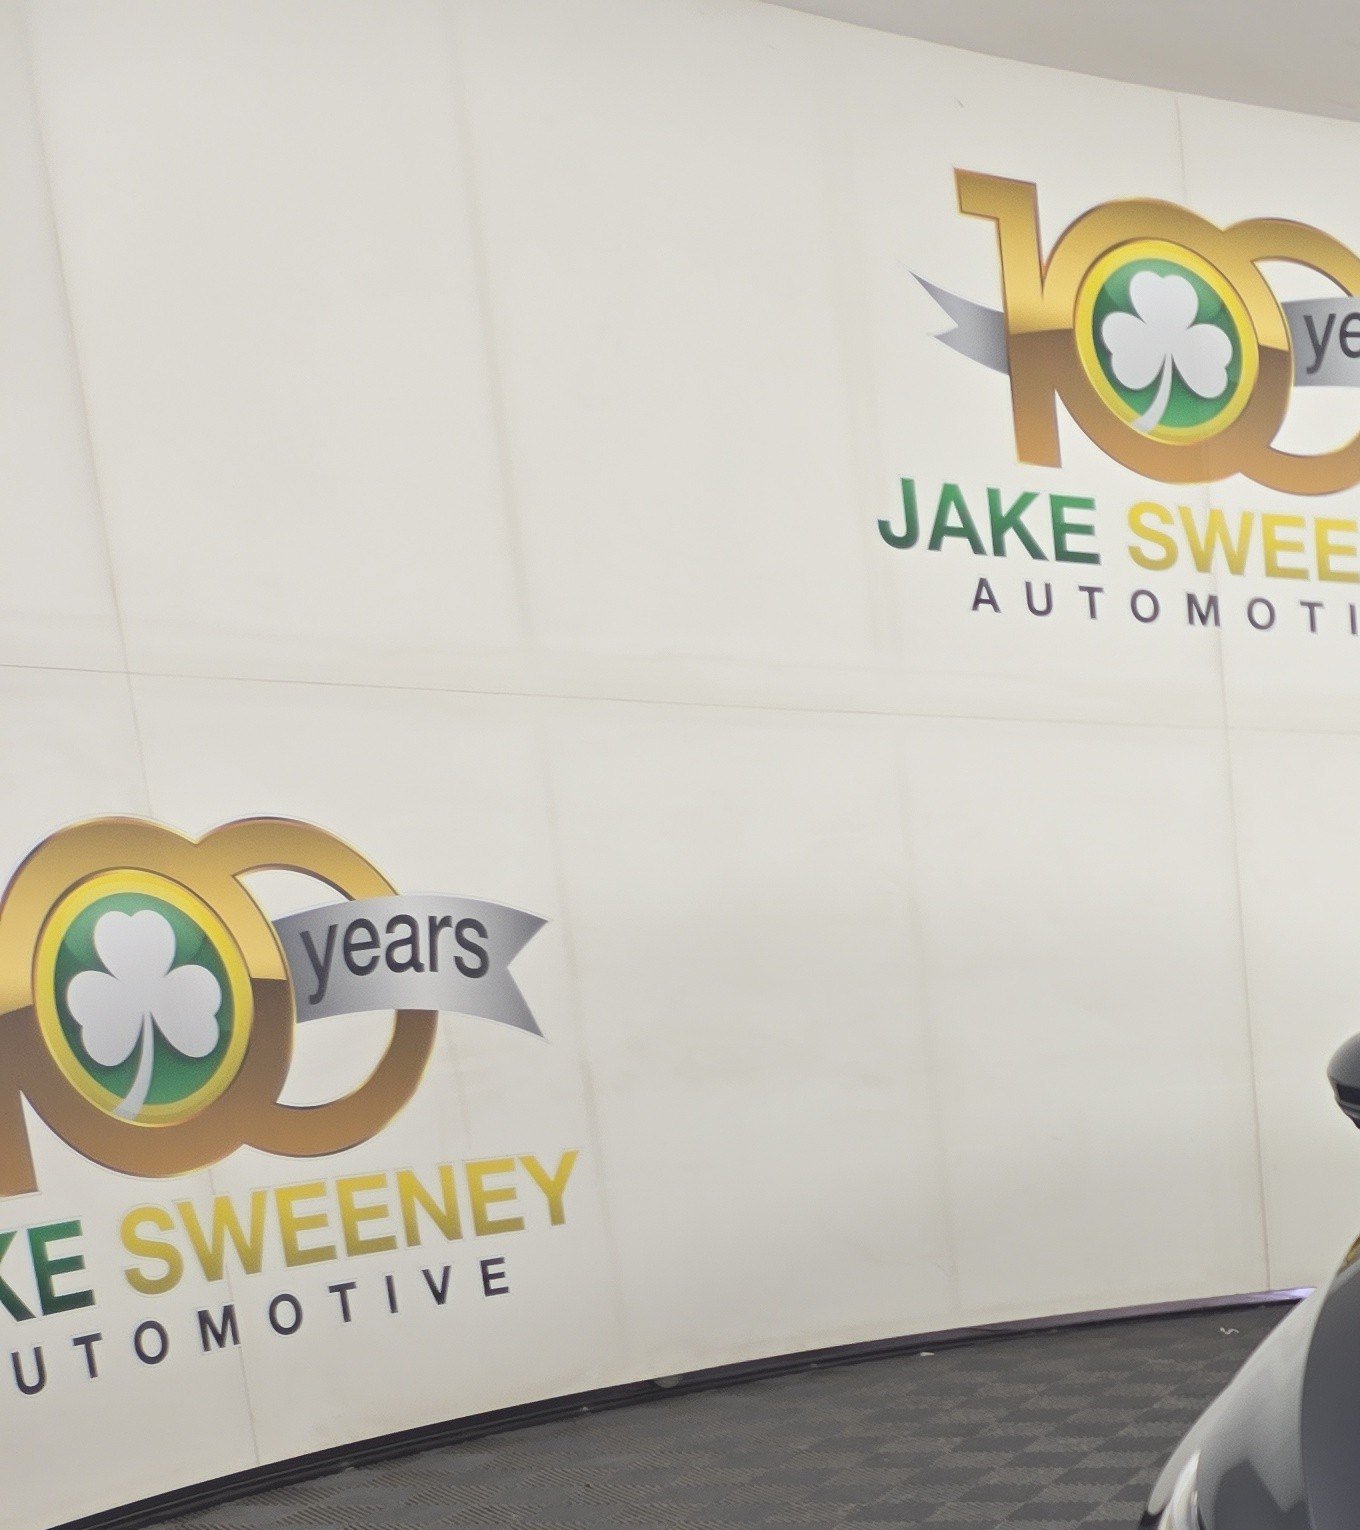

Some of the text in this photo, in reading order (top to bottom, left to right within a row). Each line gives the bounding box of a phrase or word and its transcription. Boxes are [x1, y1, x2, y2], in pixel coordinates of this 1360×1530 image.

[876, 477, 1101, 565] JAKE
[298, 914, 489, 1005] years
[119, 1149, 580, 1295] SWEENEY
